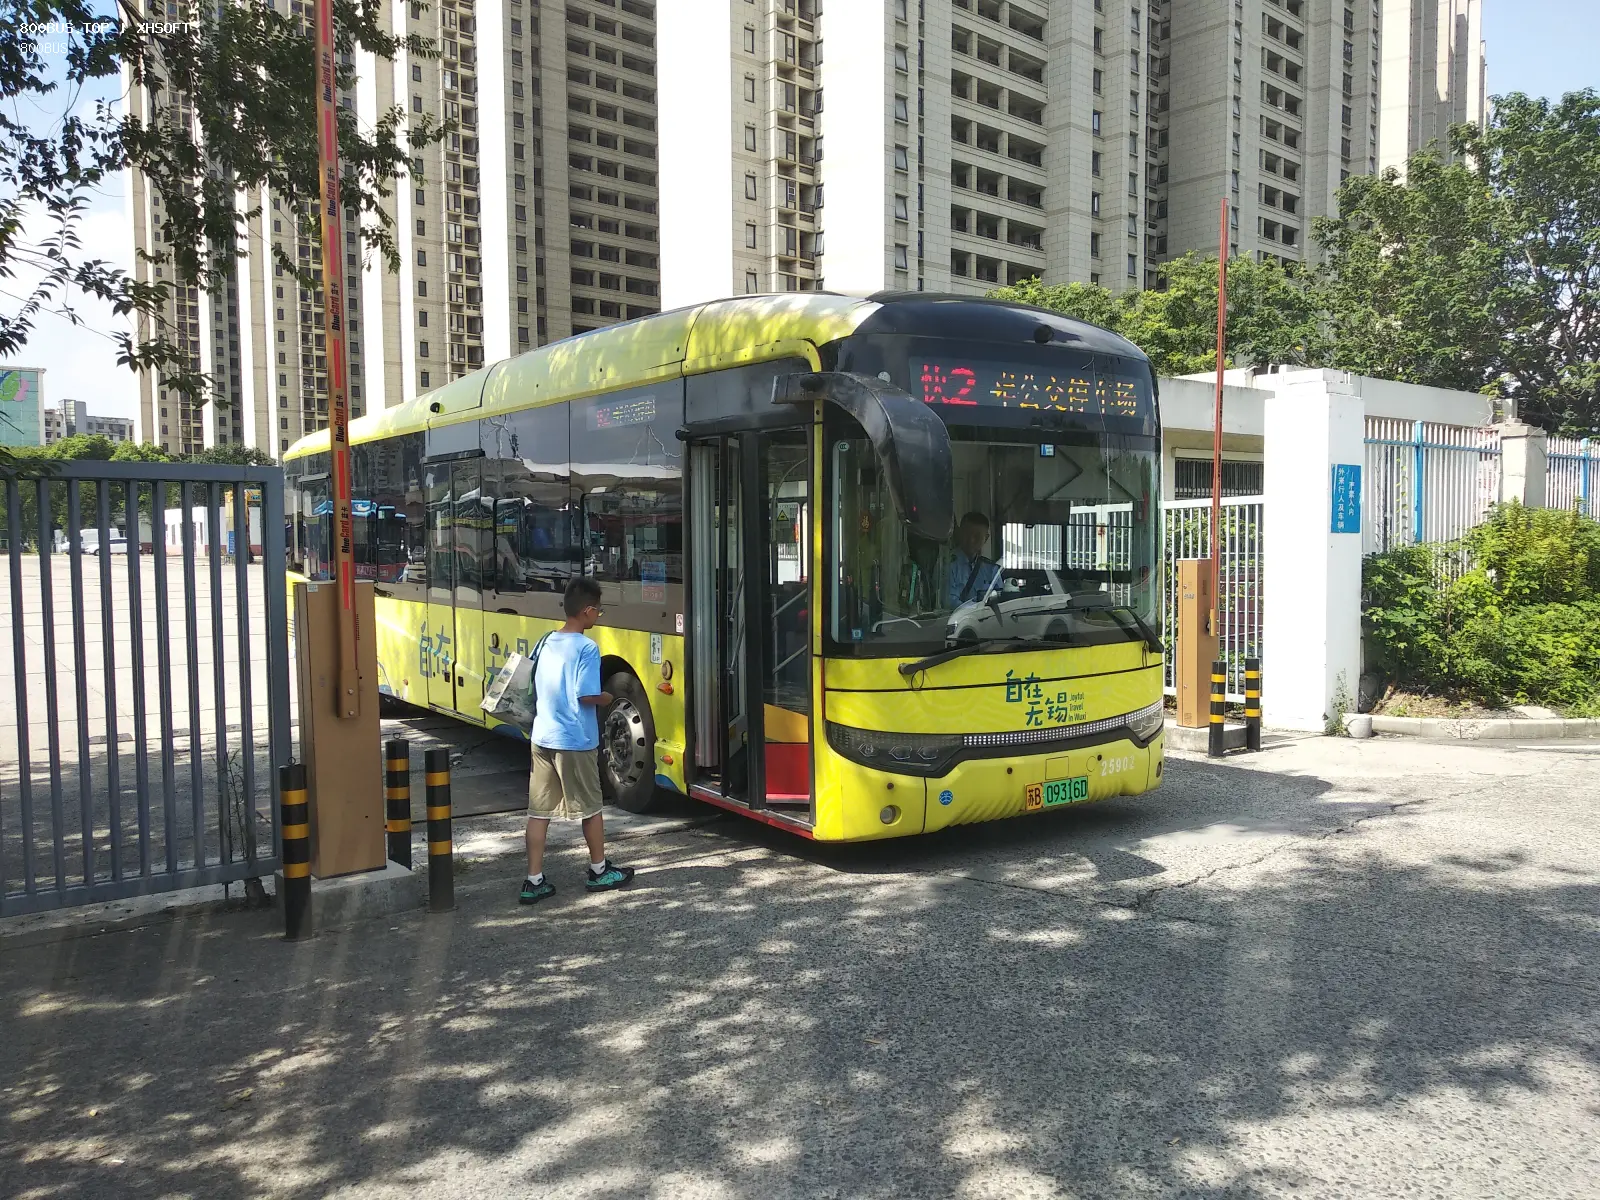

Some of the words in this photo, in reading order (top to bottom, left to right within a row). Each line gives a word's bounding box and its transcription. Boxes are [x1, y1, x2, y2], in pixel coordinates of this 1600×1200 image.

[326, 181, 336, 217] BlueCard
[330, 296, 340, 331] BlueCard
[334, 408, 345, 442] BlueCard
[340, 520, 350, 553] BlueCard
[1005, 669, 1043, 702] 自在
[1025, 691, 1067, 726] 无锡
[1069, 702, 1084, 711] Travel
[1074, 711, 1087, 721] Wuxi
